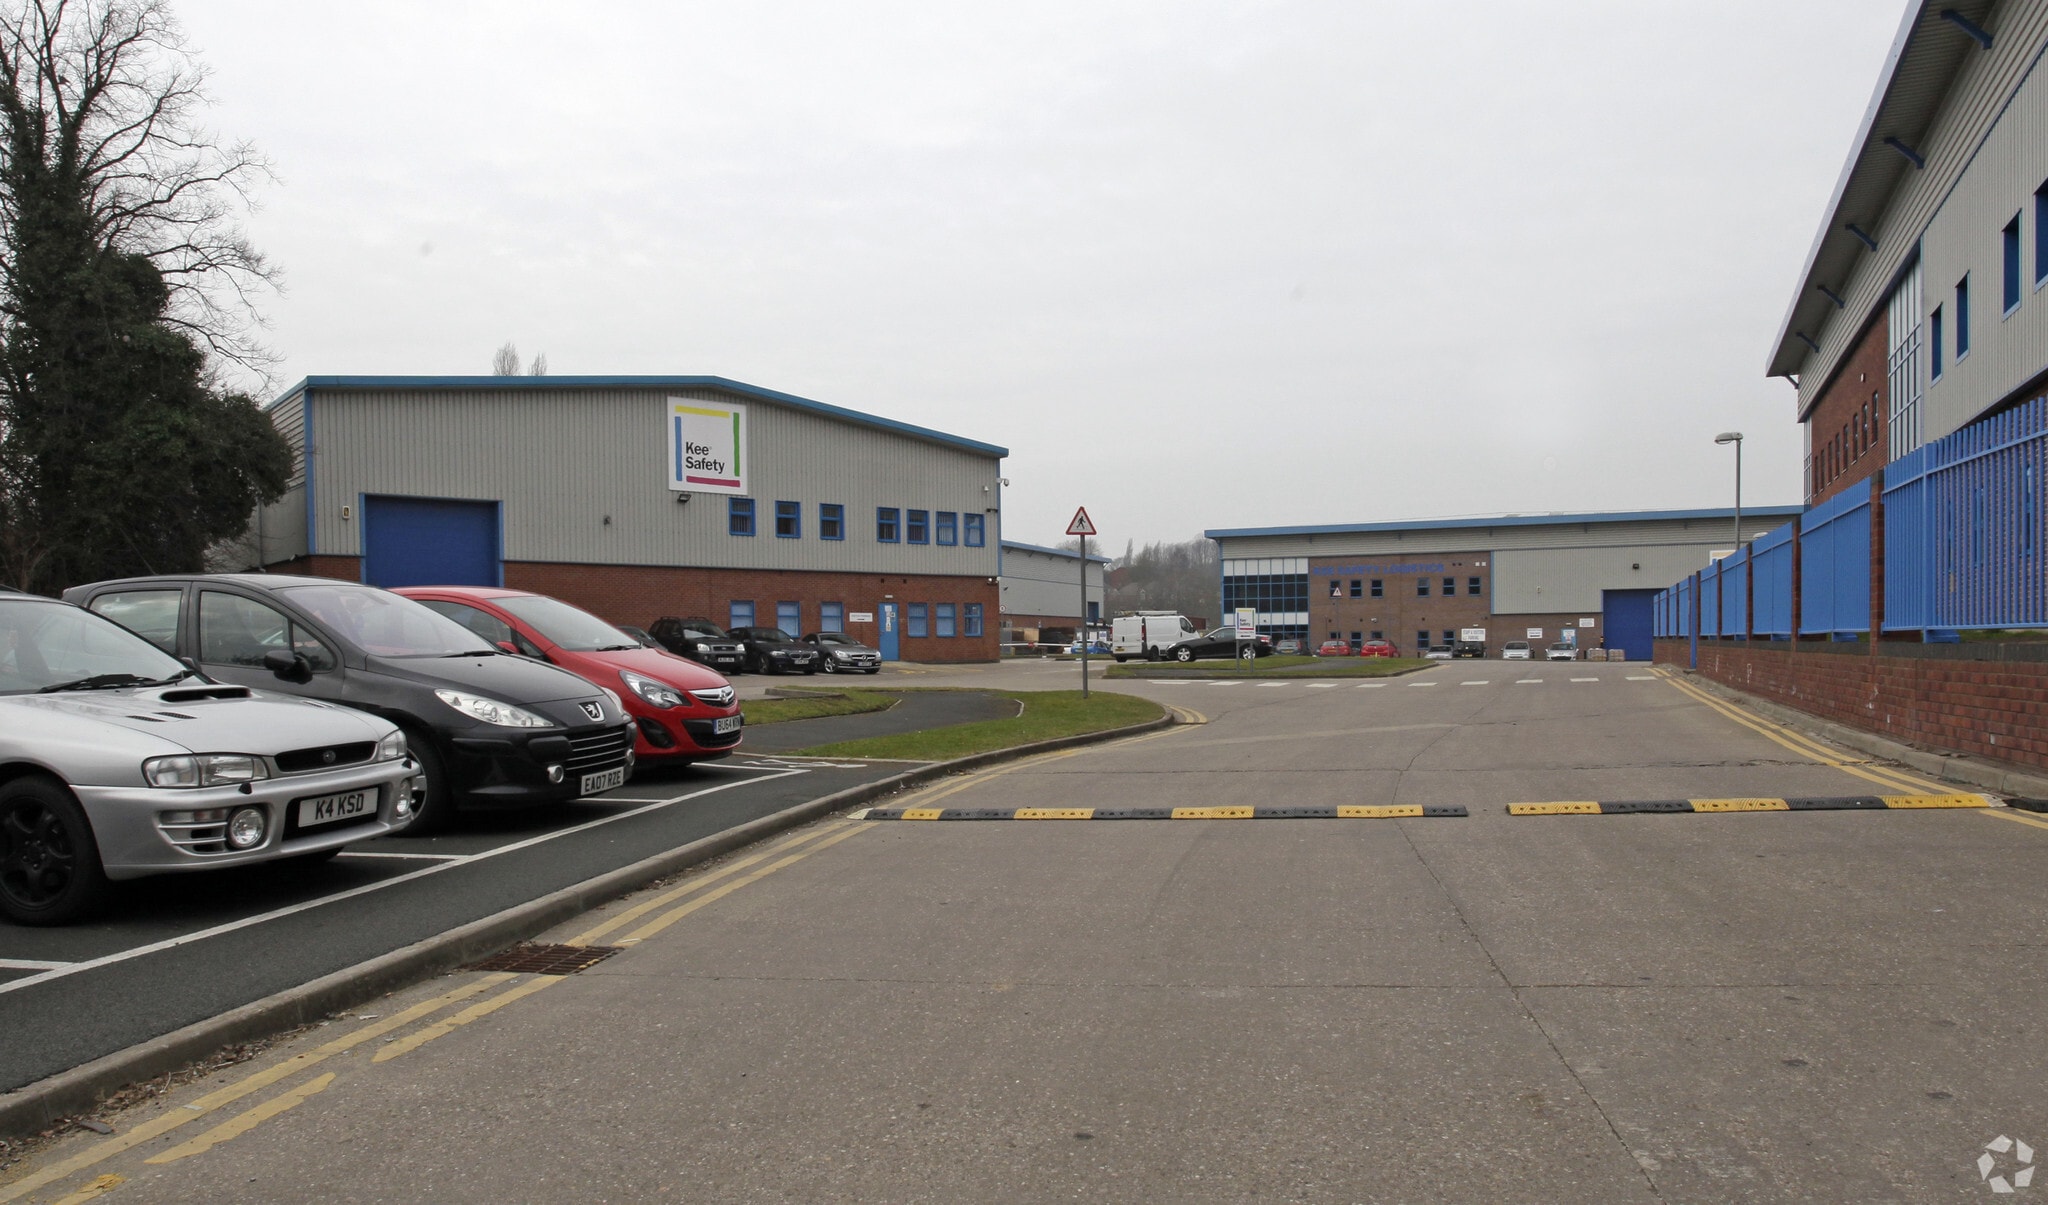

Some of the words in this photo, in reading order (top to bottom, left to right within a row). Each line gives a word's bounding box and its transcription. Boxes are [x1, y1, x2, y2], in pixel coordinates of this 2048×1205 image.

[685, 441, 709, 456] Kee
[685, 456, 725, 474] Safety
[585, 774, 607, 792] EA07
[608, 770, 621, 787] RZE
[315, 799, 334, 820] K4
[337, 793, 364, 815] KSD
